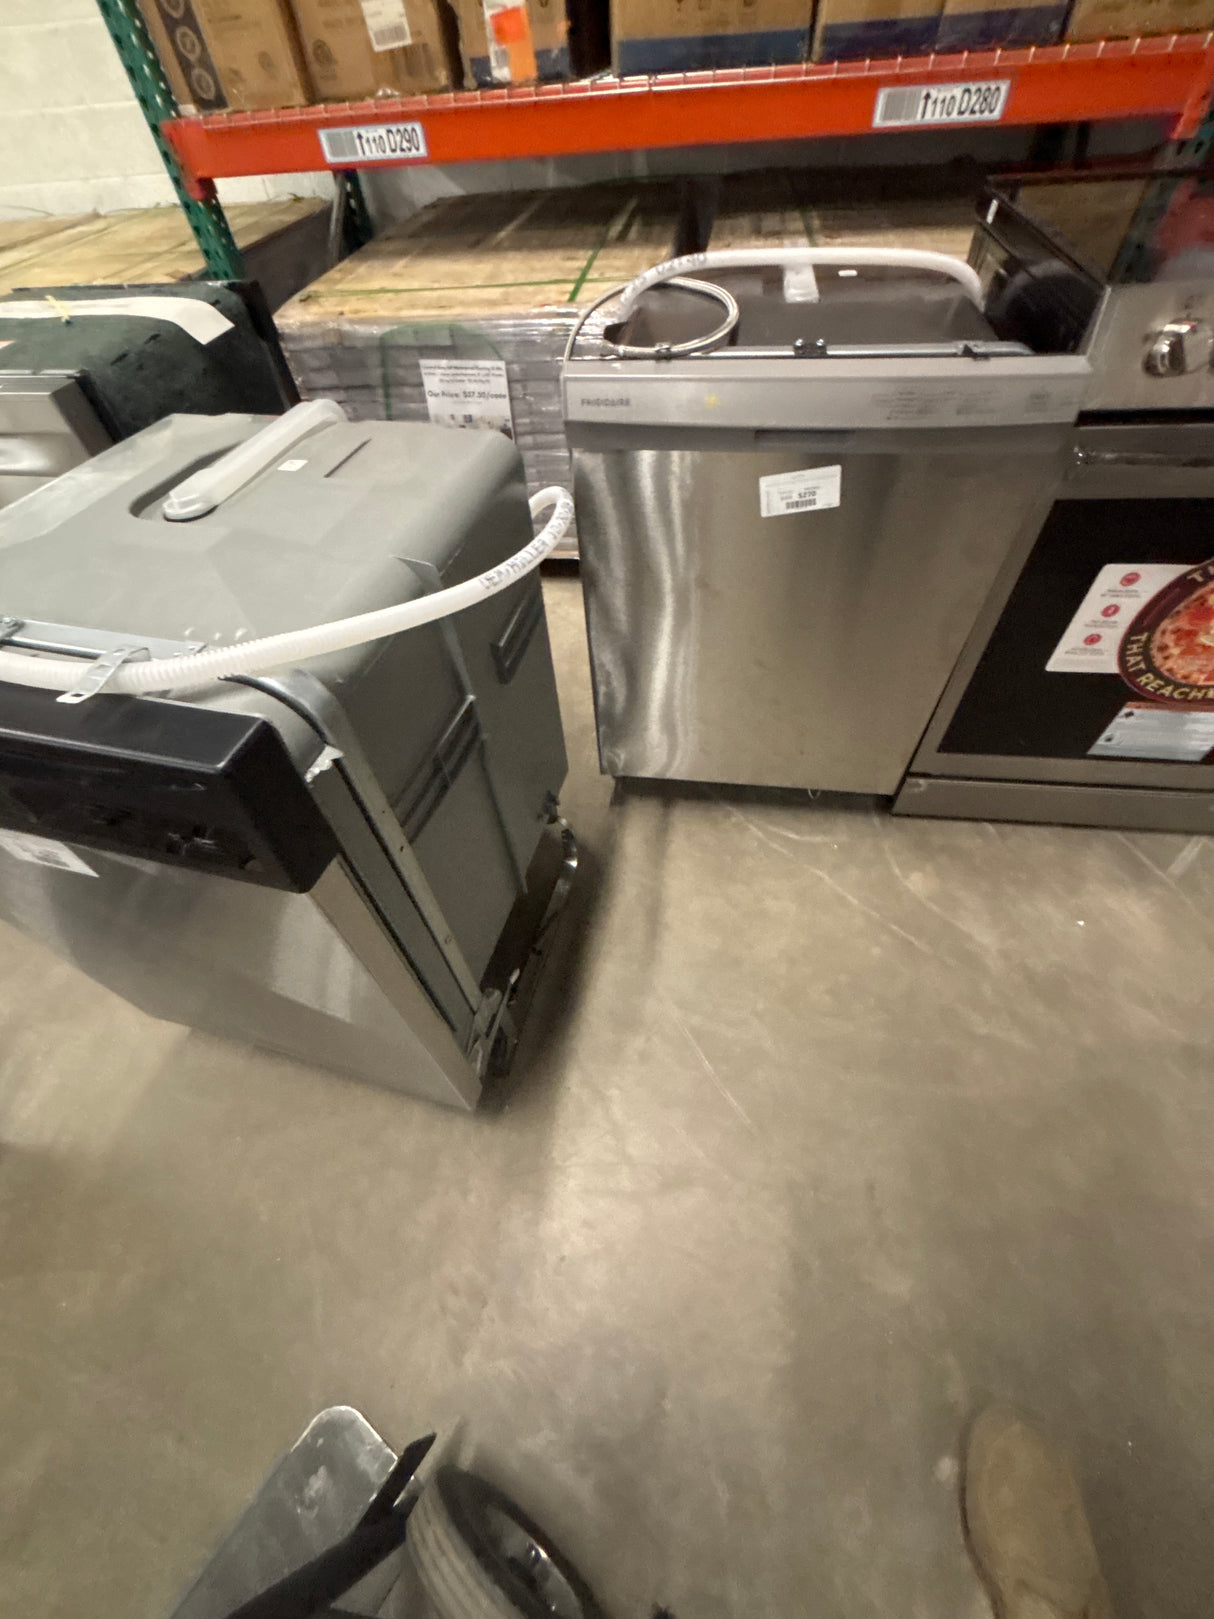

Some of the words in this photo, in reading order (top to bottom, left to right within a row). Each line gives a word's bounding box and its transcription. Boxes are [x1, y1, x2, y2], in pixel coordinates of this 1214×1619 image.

[931, 95, 956, 118] 110
[957, 86, 1001, 116] D280
[365, 134, 387, 154] 110
[386, 127, 420, 153] D290
[427, 390, 440, 398] Our
[1126, 632, 1148, 673] THAT
